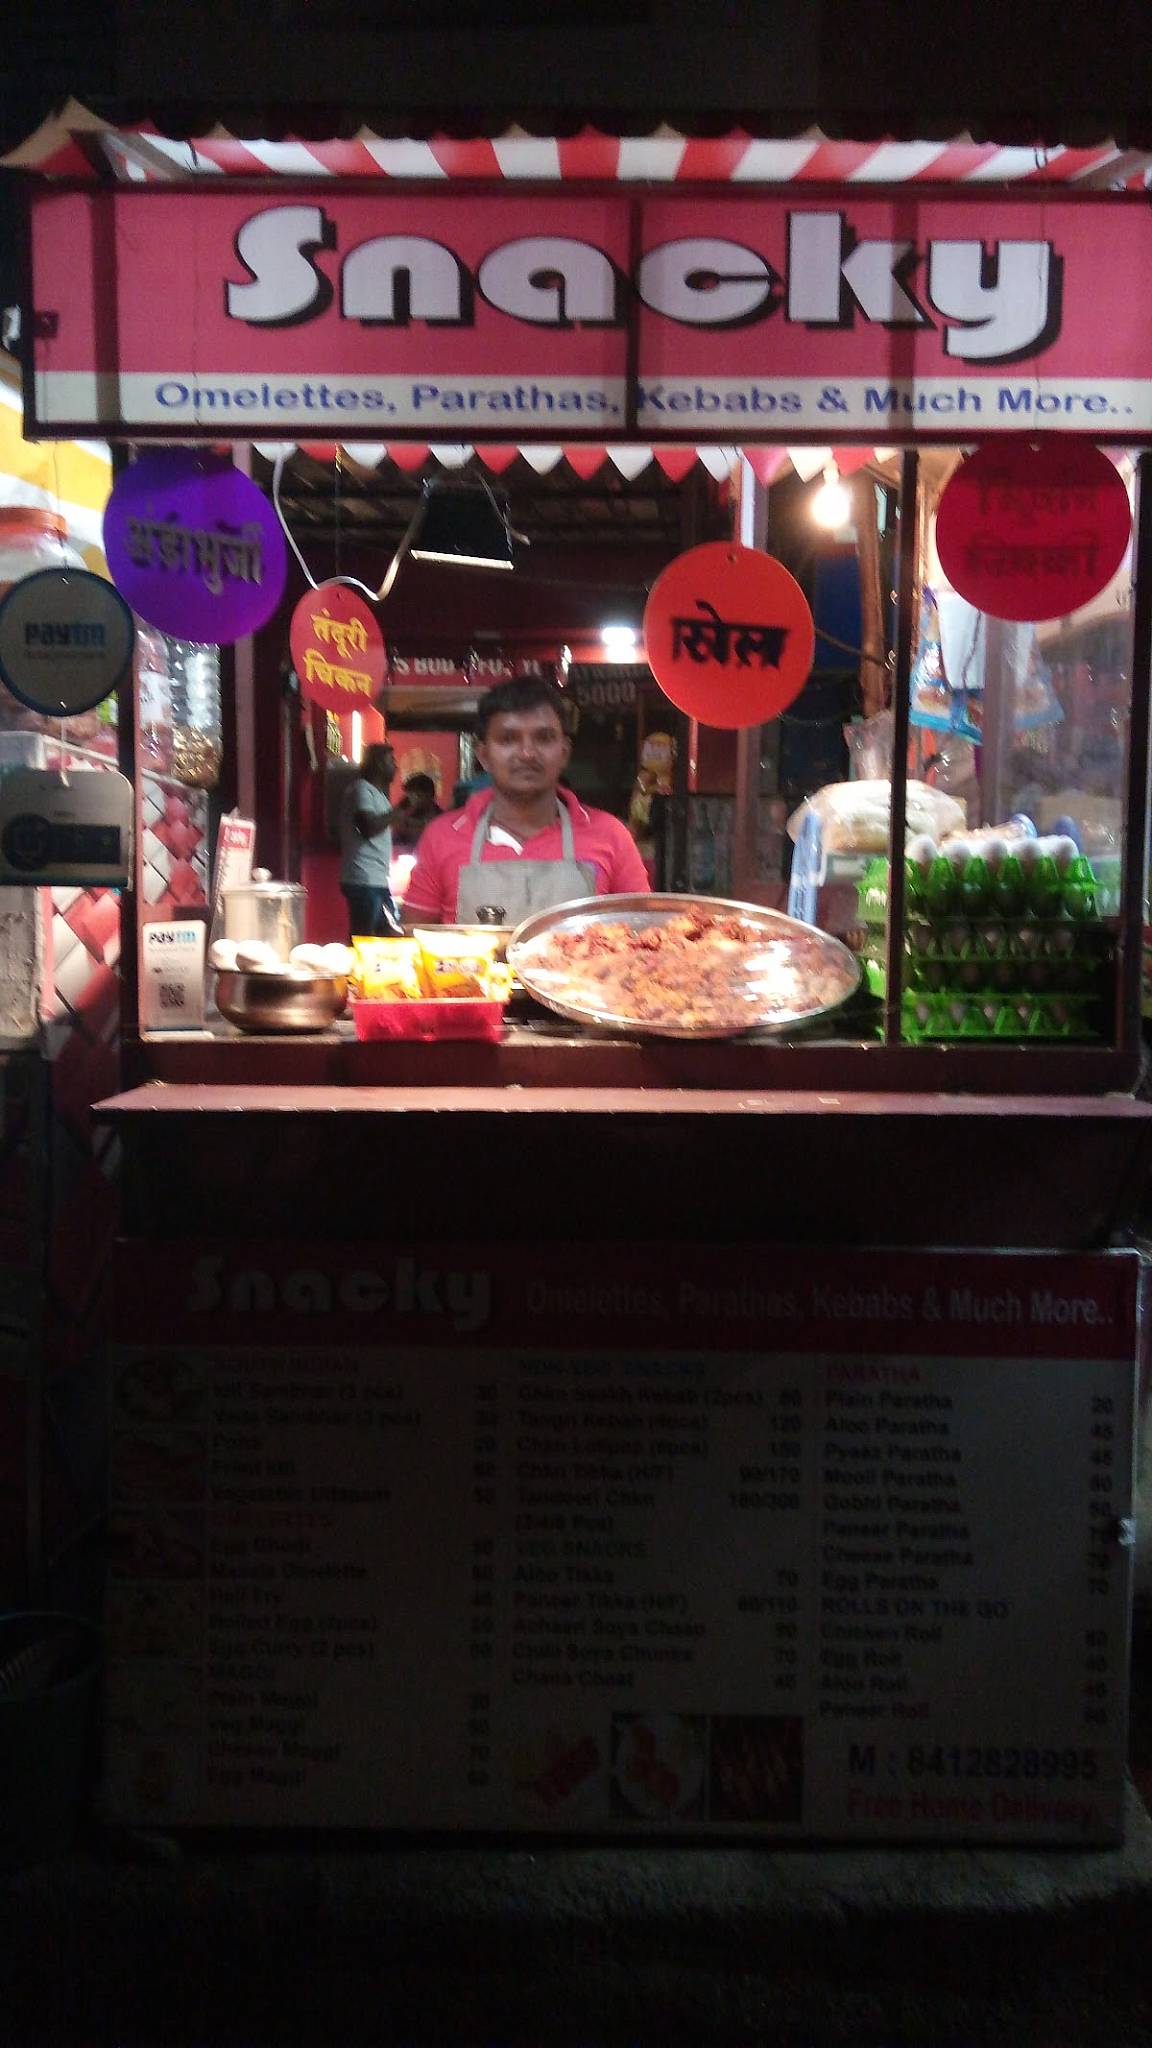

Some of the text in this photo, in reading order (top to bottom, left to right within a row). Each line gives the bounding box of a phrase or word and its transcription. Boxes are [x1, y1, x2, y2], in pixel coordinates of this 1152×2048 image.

[225, 205, 1061, 365] Snacky
[155, 381, 1134, 415] Omelettes, Parathas, Kebabs & Much More..
[187, 1253, 493, 1332] Snacky
[811, 1283, 912, 1320] Kebabs
[922, 1286, 941, 1321] &
[948, 1288, 1023, 1324] Much
[820, 1597, 1010, 1619] ROLLS ON THE GO
[848, 1743, 877, 1777] M
[906, 1744, 1100, 1781] 8412828995
